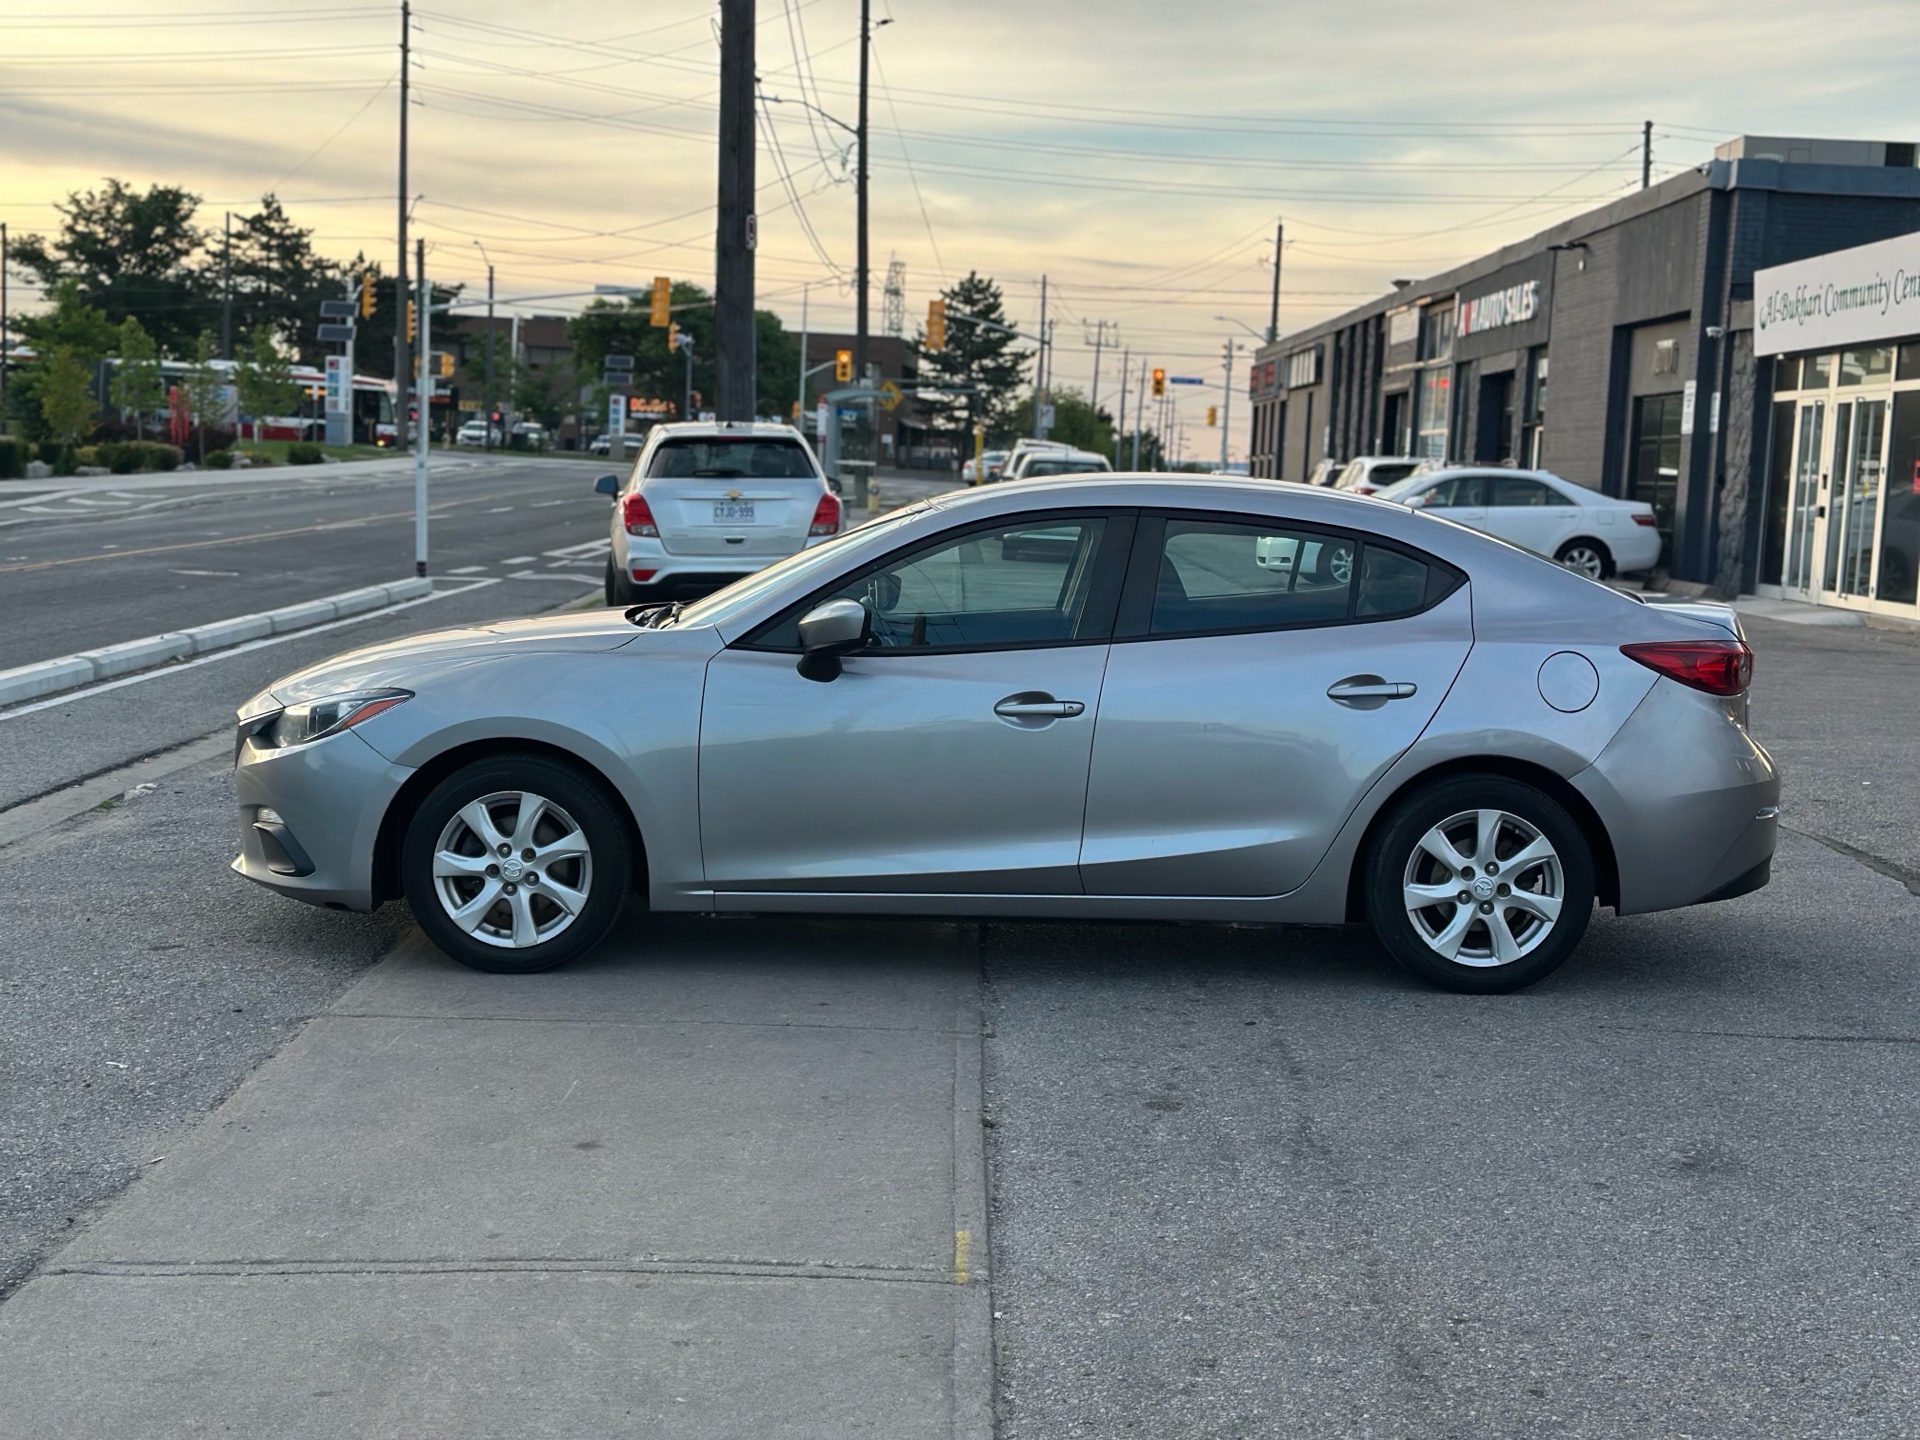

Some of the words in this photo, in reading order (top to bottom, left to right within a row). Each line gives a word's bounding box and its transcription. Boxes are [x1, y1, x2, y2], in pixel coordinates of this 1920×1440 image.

[1477, 290, 1505, 330] AUTO
[1504, 279, 1540, 325] SALES
[1759, 284, 1823, 330] Al-Bukhari
[1824, 272, 1891, 317] Community
